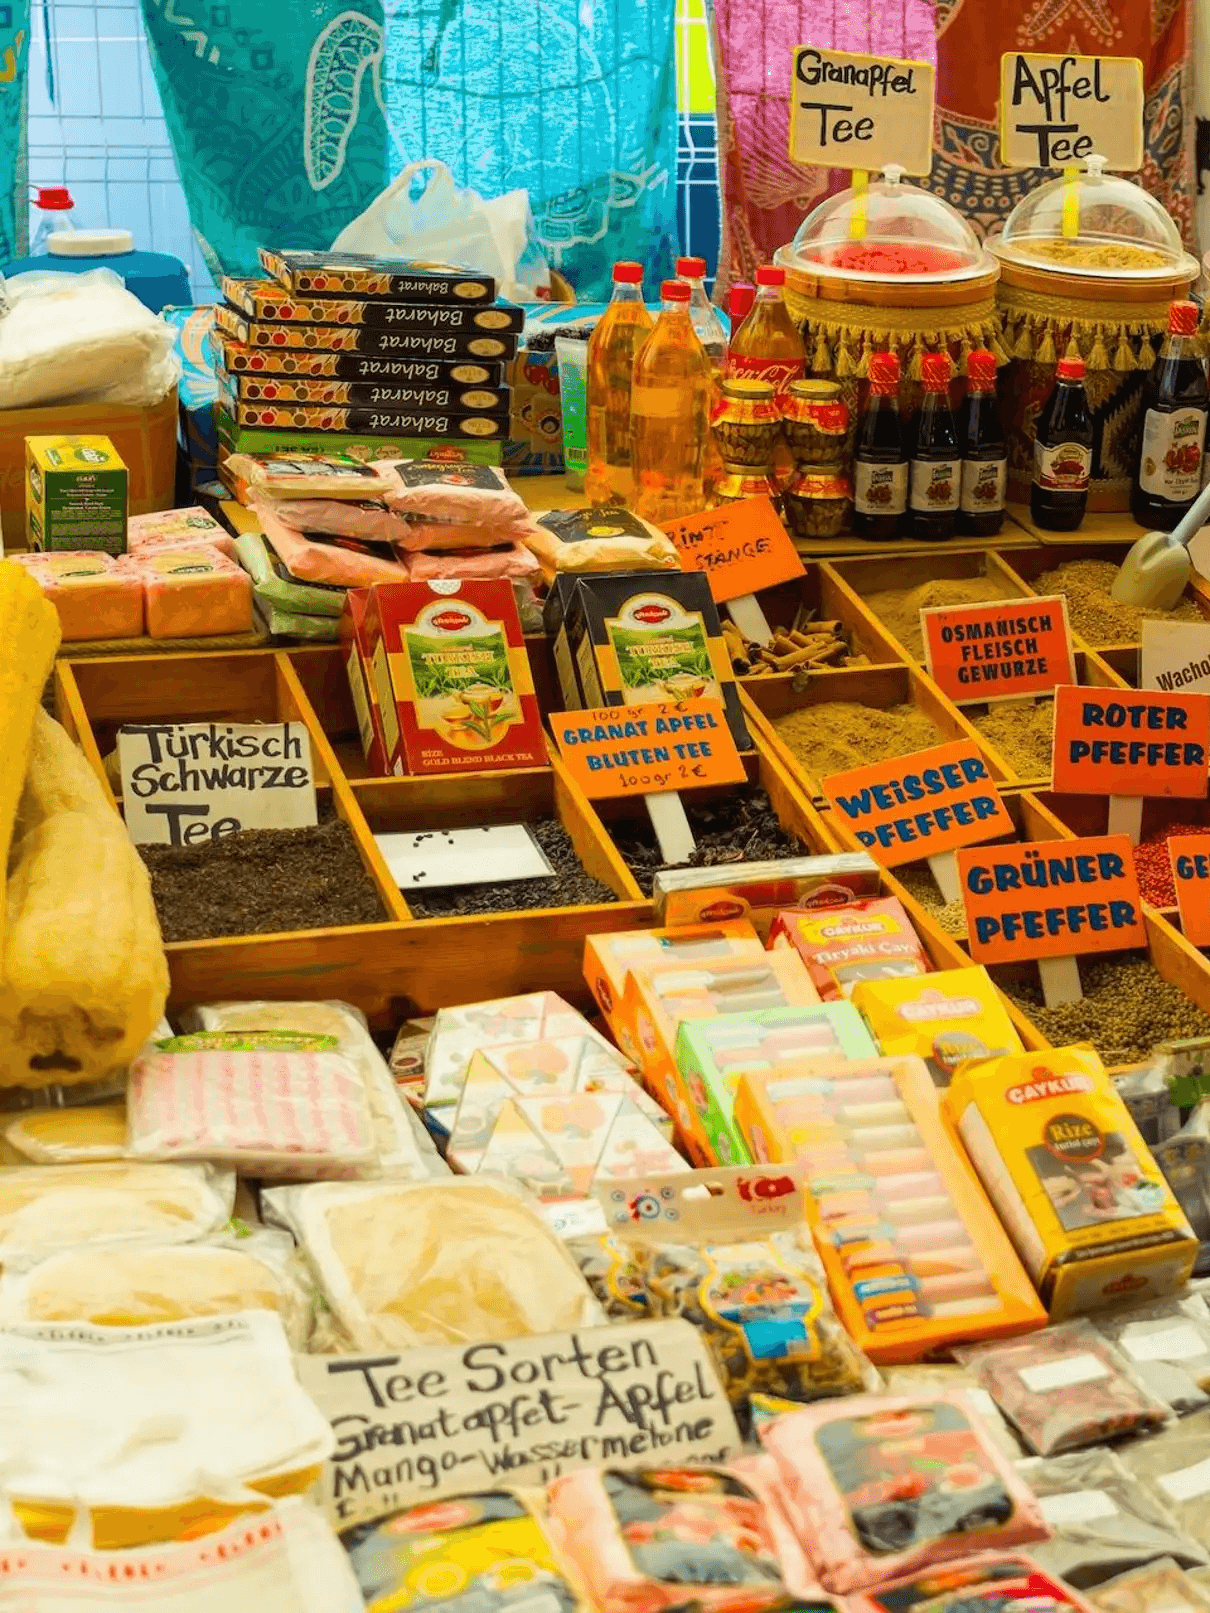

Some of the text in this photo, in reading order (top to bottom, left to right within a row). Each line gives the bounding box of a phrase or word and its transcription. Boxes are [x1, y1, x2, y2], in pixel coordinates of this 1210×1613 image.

[1011, 54, 1110, 122] Apfel
[800, 101, 875, 147] Tee
[1015, 124, 1093, 168] Tee
[398, 280, 448, 293] Baharat
[385, 307, 464, 326] Baharat
[379, 336, 457, 354] Baharat
[359, 363, 440, 381] Baharat
[370, 388, 449, 406] Baharat
[369, 416, 449, 433] Baharat
[941, 615, 1053, 643] OSMANISCH
[961, 637, 1038, 662] FLEISCH
[563, 712, 719, 746] GRANAT APFEL
[592, 709, 620, 721] 100
[1082, 702, 1187, 730] ROTER
[120, 723, 302, 764] Türkisch
[586, 741, 713, 771] BLUTEN TEE
[1069, 739, 1204, 766] PFEFFER
[422, 752, 534, 766] GOLD BLEND BLACK TEA
[131, 762, 310, 799] Schwarze
[145, 803, 241, 847] Tee
[854, 796, 1000, 848] PFEFFER
[966, 850, 1125, 895] GRÜNER
[974, 900, 1138, 944] PFEFFER
[1050, 1120, 1095, 1142] Rize
[327, 1333, 660, 1409] Tee Sorten
[593, 1360, 716, 1428] Apfel
